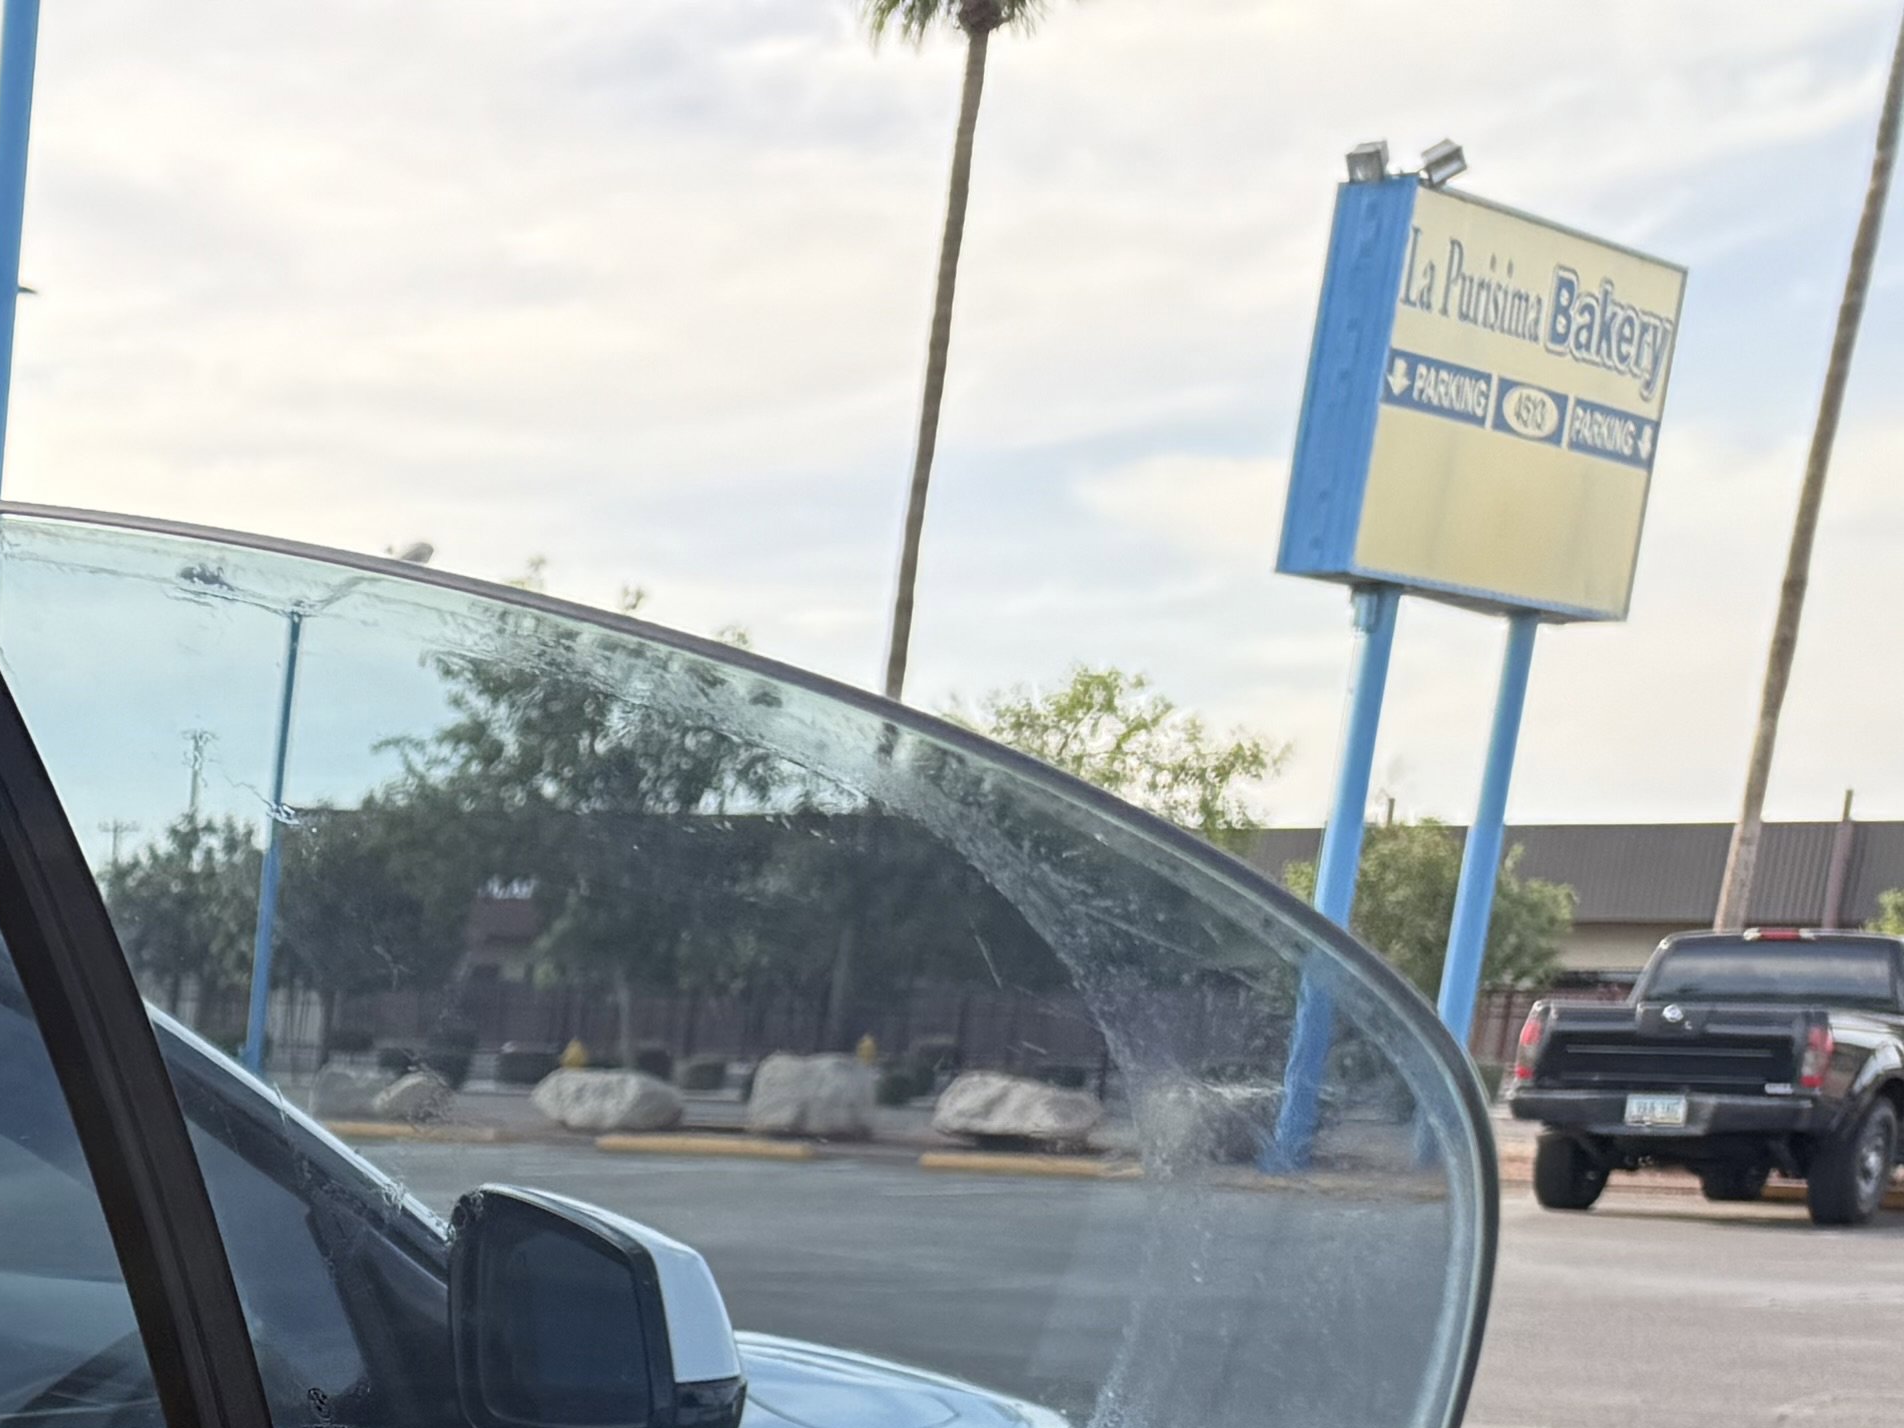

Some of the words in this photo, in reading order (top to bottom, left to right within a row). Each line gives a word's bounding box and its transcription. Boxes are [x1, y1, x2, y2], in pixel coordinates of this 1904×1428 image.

[1400, 225, 1436, 311] La
[1545, 264, 1673, 403] Bakery
[1412, 363, 1489, 418] PARKING
[1571, 406, 1636, 456] PARKING
